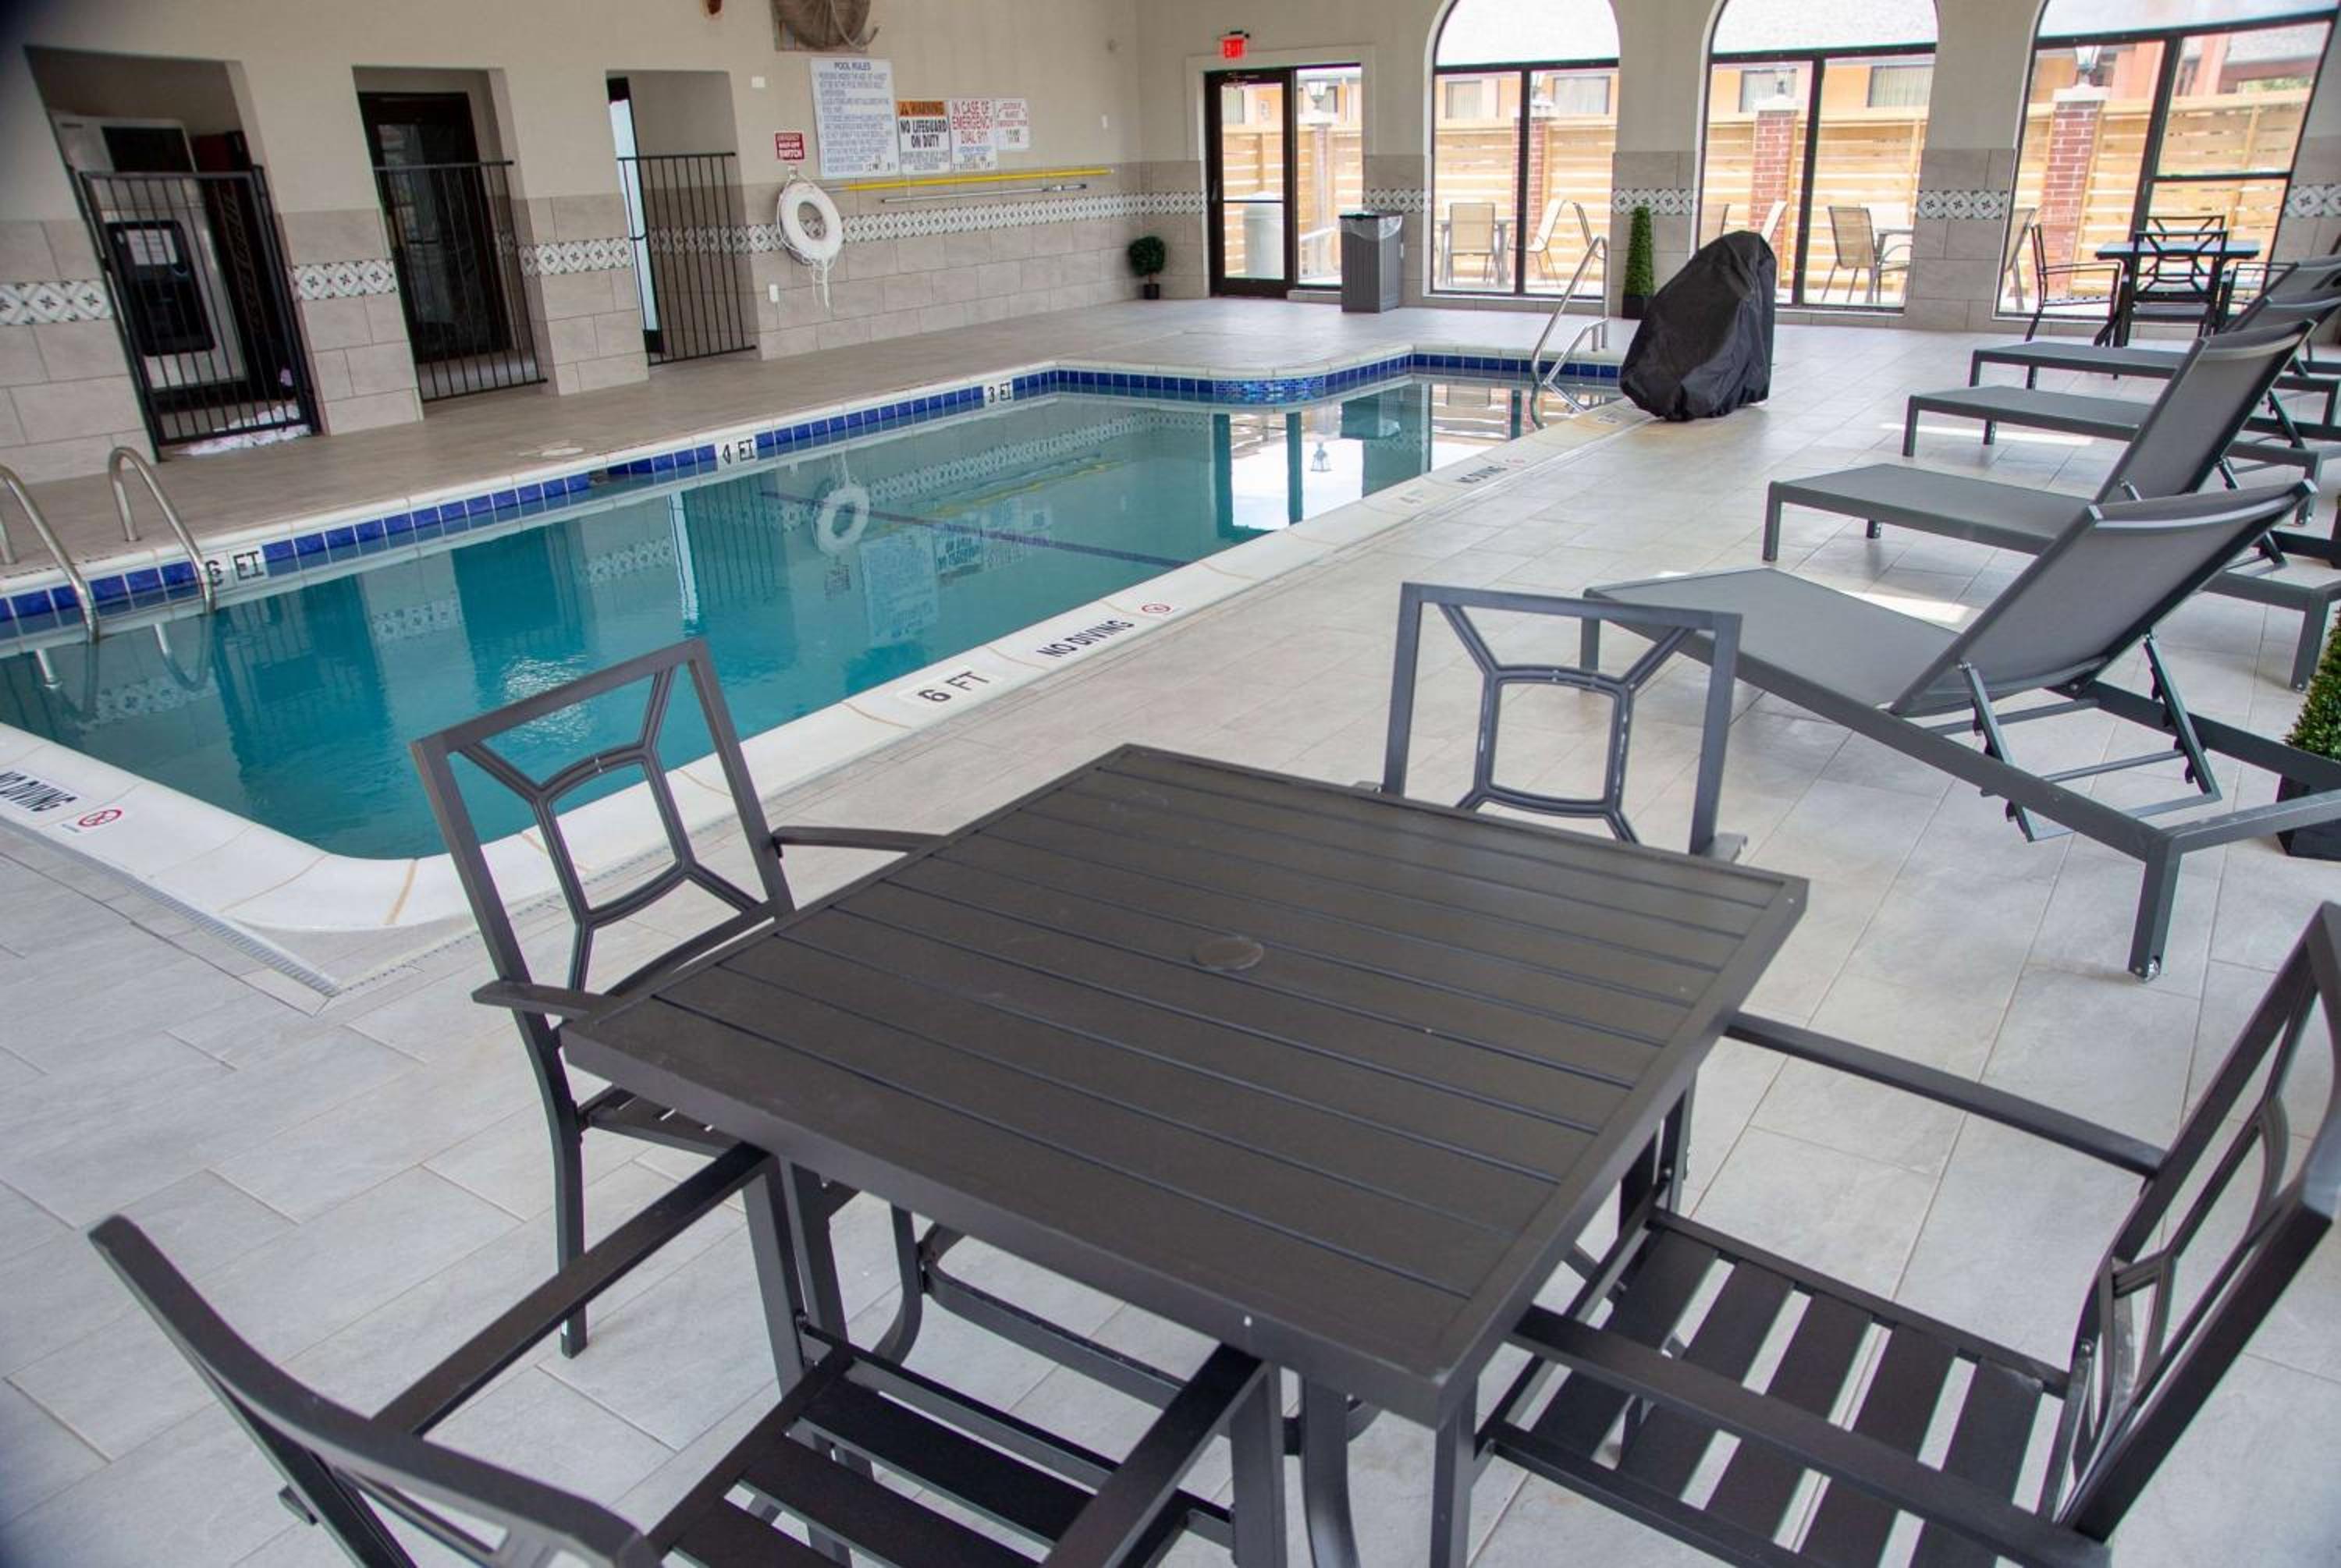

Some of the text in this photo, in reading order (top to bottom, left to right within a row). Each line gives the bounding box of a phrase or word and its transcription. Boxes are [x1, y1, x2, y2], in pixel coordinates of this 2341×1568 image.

[1224, 37, 1244, 54] EXIT
[834, 62, 872, 71] POOL RULES
[911, 102, 944, 115] WARNING
[953, 101, 961, 115] IN
[961, 101, 979, 115] CASE
[981, 101, 989, 114] OF
[900, 120, 911, 133] NO
[912, 119, 947, 133] LIFEGUARD
[952, 115, 993, 130] EMERGENCY
[911, 134, 940, 148] ON DUTY
[961, 130, 976, 144] DIAL
[987, 386, 995, 403] 3
[1036, 620, 1135, 658] NO DIVING
[917, 671, 990, 702] 6 FT
[0, 780, 78, 812] DIVING
